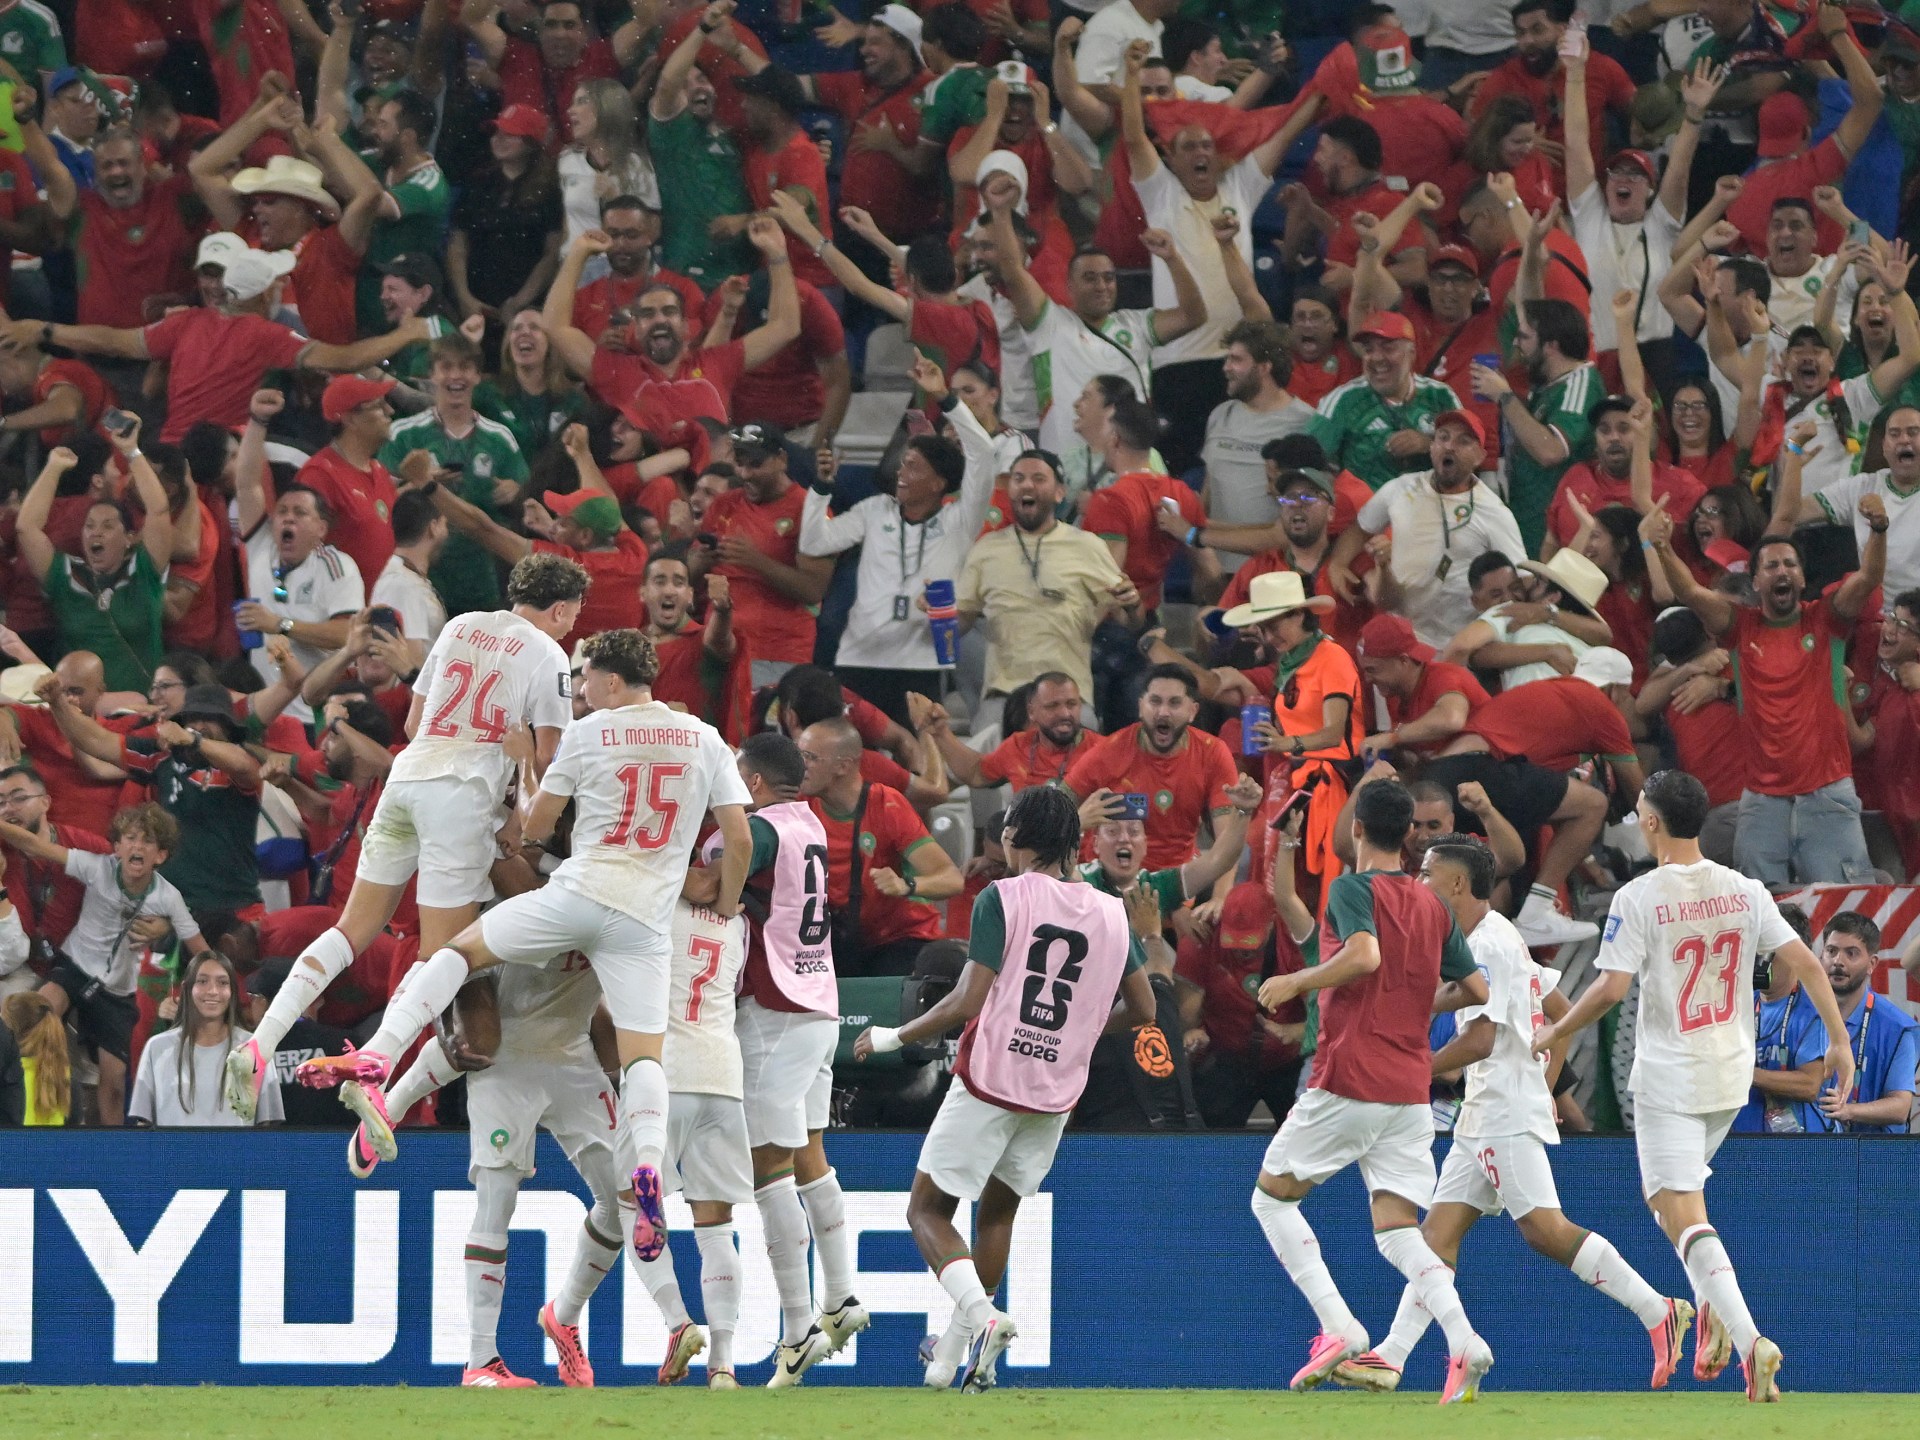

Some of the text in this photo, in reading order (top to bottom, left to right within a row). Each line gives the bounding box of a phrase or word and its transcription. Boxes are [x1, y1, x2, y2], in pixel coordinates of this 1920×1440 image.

[424, 658, 511, 743] 24
[601, 728, 701, 748] EL MOURABET
[600, 762, 692, 853] 15
[1656, 893, 1751, 926] EL KHANNOUSS
[806, 925, 822, 937] FIFA
[795, 949, 825, 960] WORLD CUP
[794, 960, 830, 975] 2026
[685, 933, 727, 1026] 7
[1672, 928, 1744, 1035] 23
[1030, 1005, 1055, 1022] FIFA
[1043, 1034, 1062, 1047] CUP
[275, 1048, 327, 1066] ERZA
[1007, 1038, 1059, 1063] 2026
[1756, 1044, 1789, 1063] EAM
